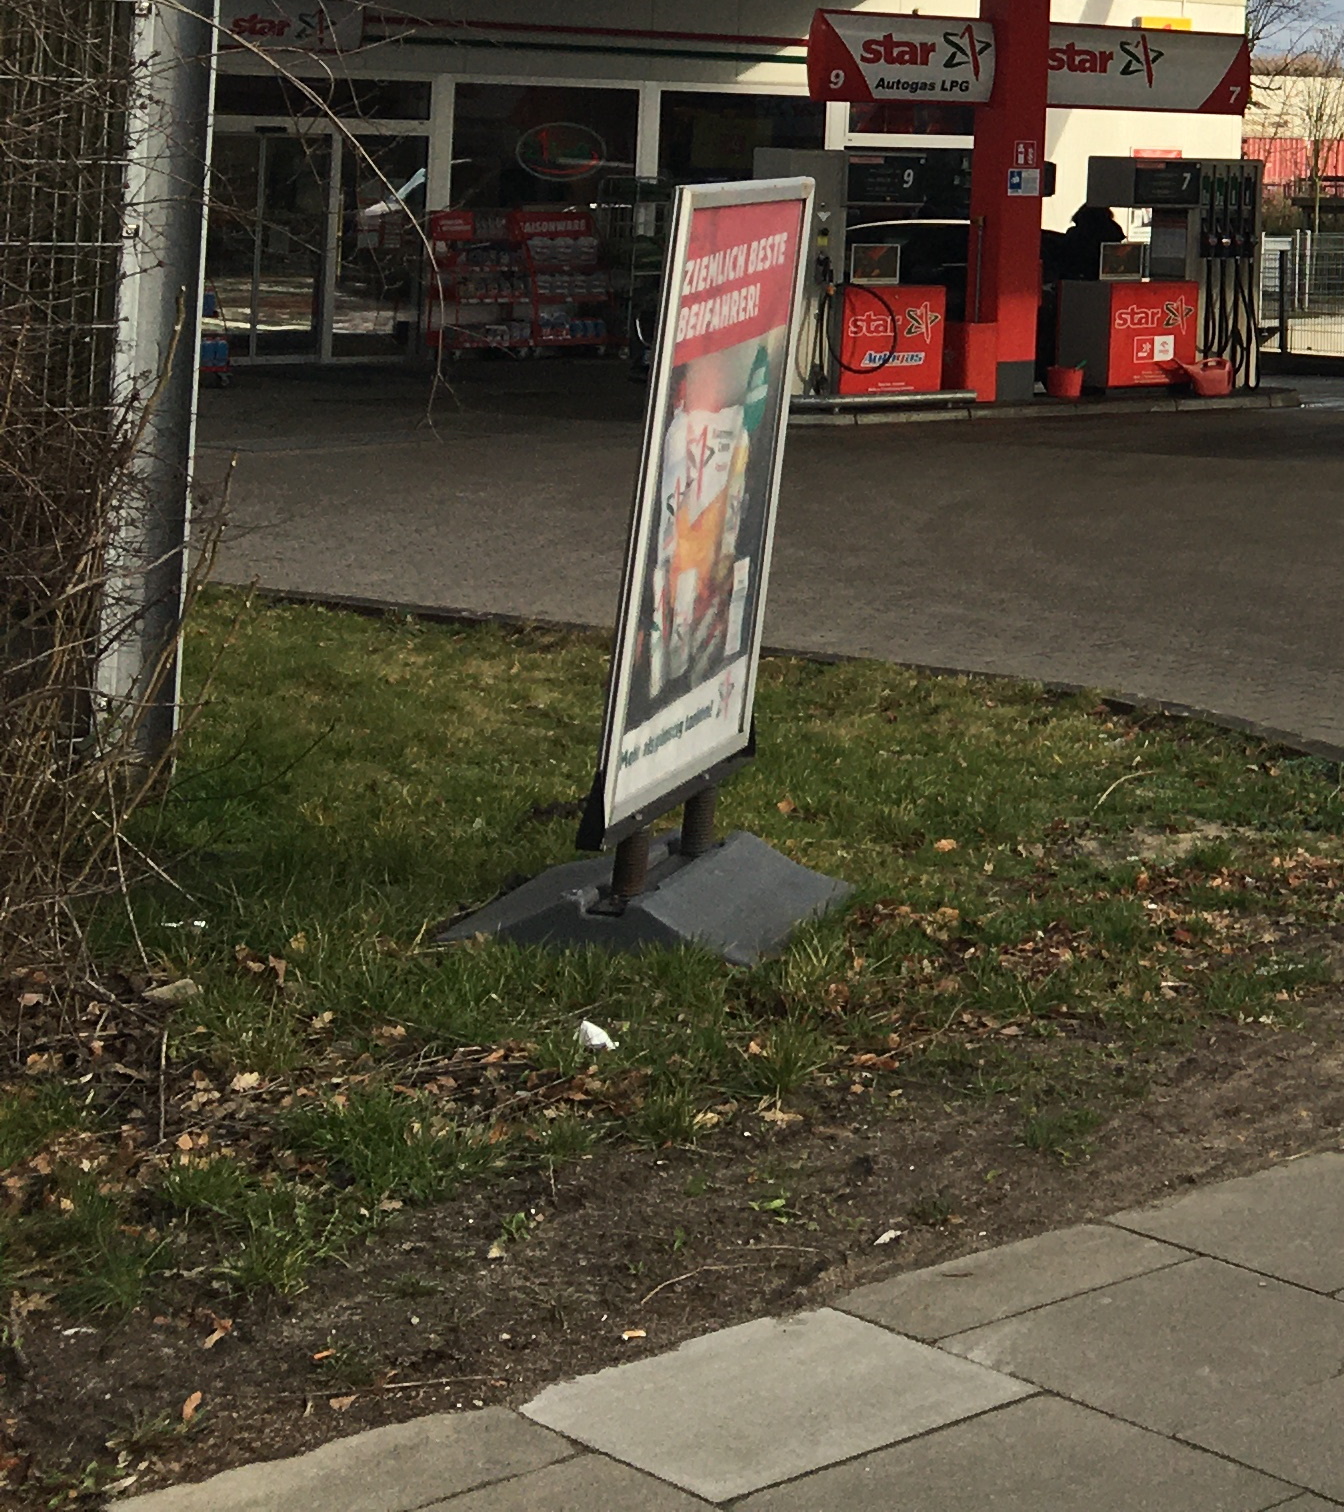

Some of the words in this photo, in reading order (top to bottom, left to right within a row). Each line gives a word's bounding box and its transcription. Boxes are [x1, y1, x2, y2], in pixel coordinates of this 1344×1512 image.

[229, 14, 291, 36] star
[859, 33, 936, 68] star
[1048, 42, 1114, 73] star
[829, 69, 845, 89] 9
[875, 78, 936, 93] Autogas
[940, 80, 970, 92] LPG
[1229, 86, 1241, 103] 7
[902, 168, 914, 189] 9
[1181, 172, 1192, 190] 7
[682, 244, 748, 296] ZIEMLICH
[748, 232, 787, 275] BESTE
[676, 283, 760, 343] BEIFAHRER!
[848, 311, 903, 336] star
[1115, 305, 1162, 329] star
